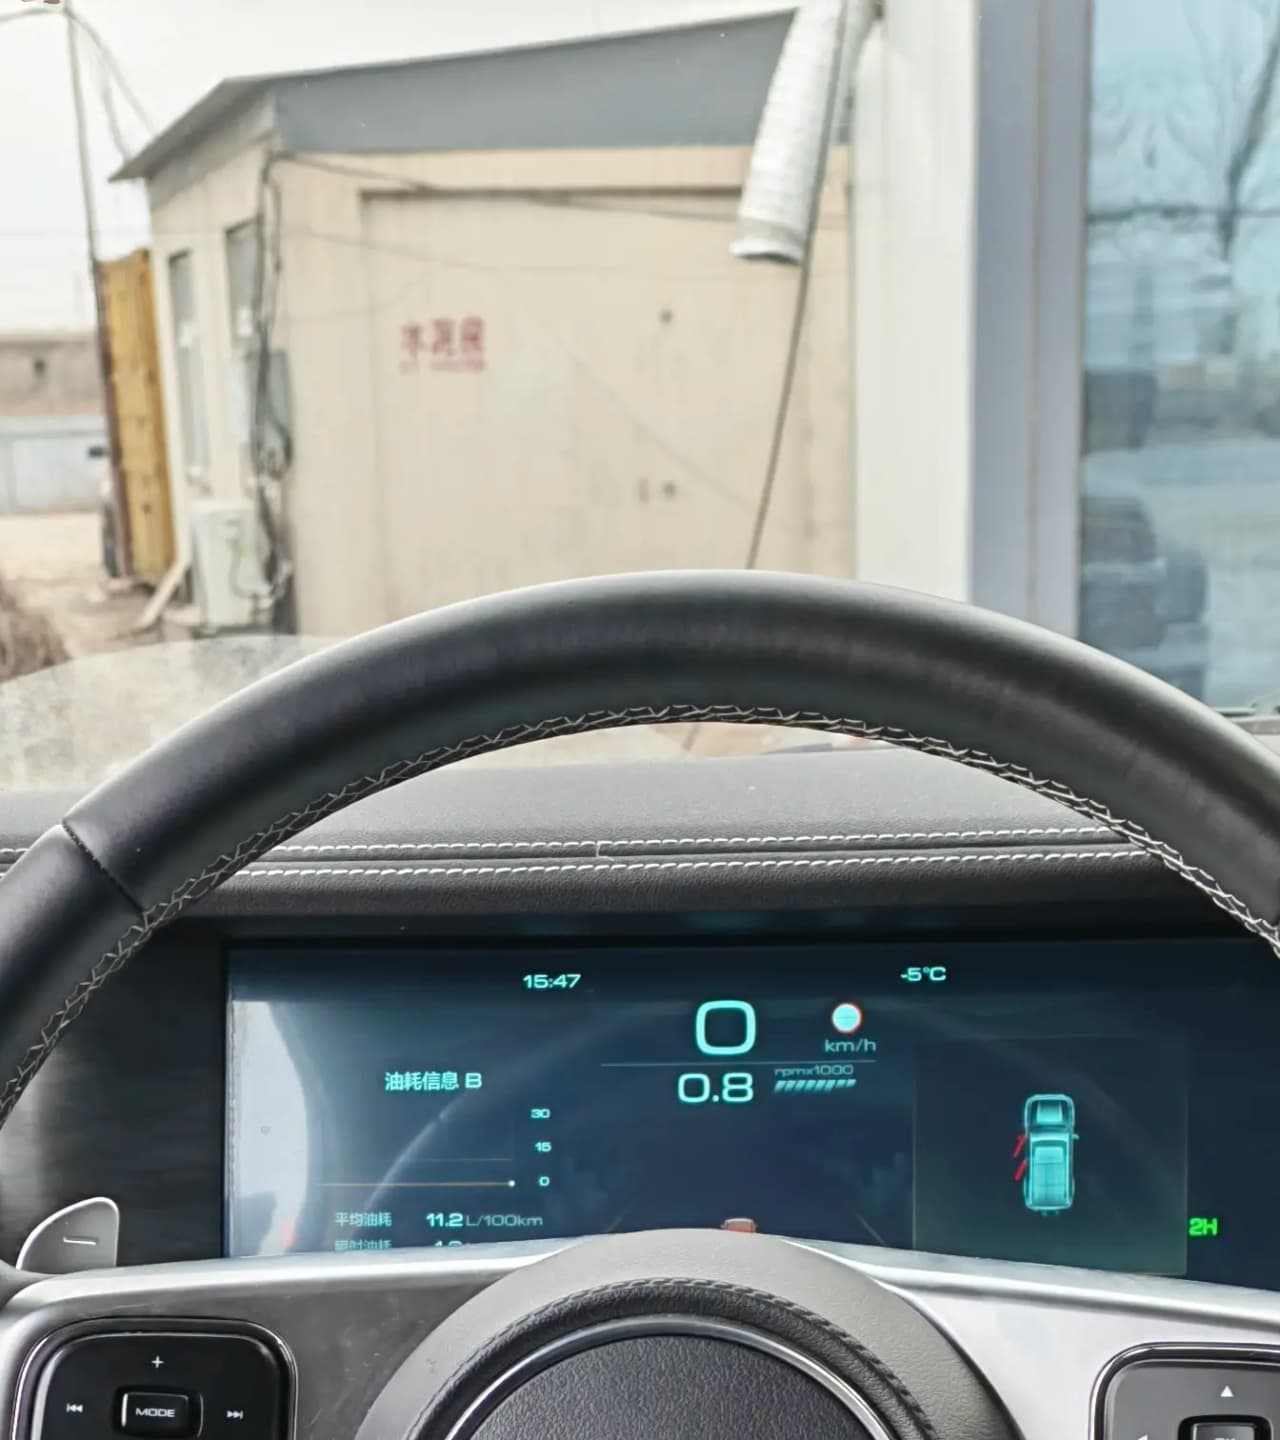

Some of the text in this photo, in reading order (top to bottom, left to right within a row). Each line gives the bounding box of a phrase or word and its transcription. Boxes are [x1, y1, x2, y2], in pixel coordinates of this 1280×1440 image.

[523, 973, 582, 989] 15:47
[900, 966, 947, 982] -5°C
[695, 999, 757, 1056] 0
[824, 1038, 877, 1053] km/h
[384, 1071, 483, 1092] 油耗信息 B
[677, 1072, 754, 1104] 0.8
[530, 1108, 551, 1119] 30
[535, 1141, 552, 1153] 15
[538, 1176, 551, 1187] 0
[334, 1212, 544, 1228] 平均油耗 11.2 L/100km
[1188, 1217, 1218, 1237] 2H
[135, 1407, 176, 1418] MODE
